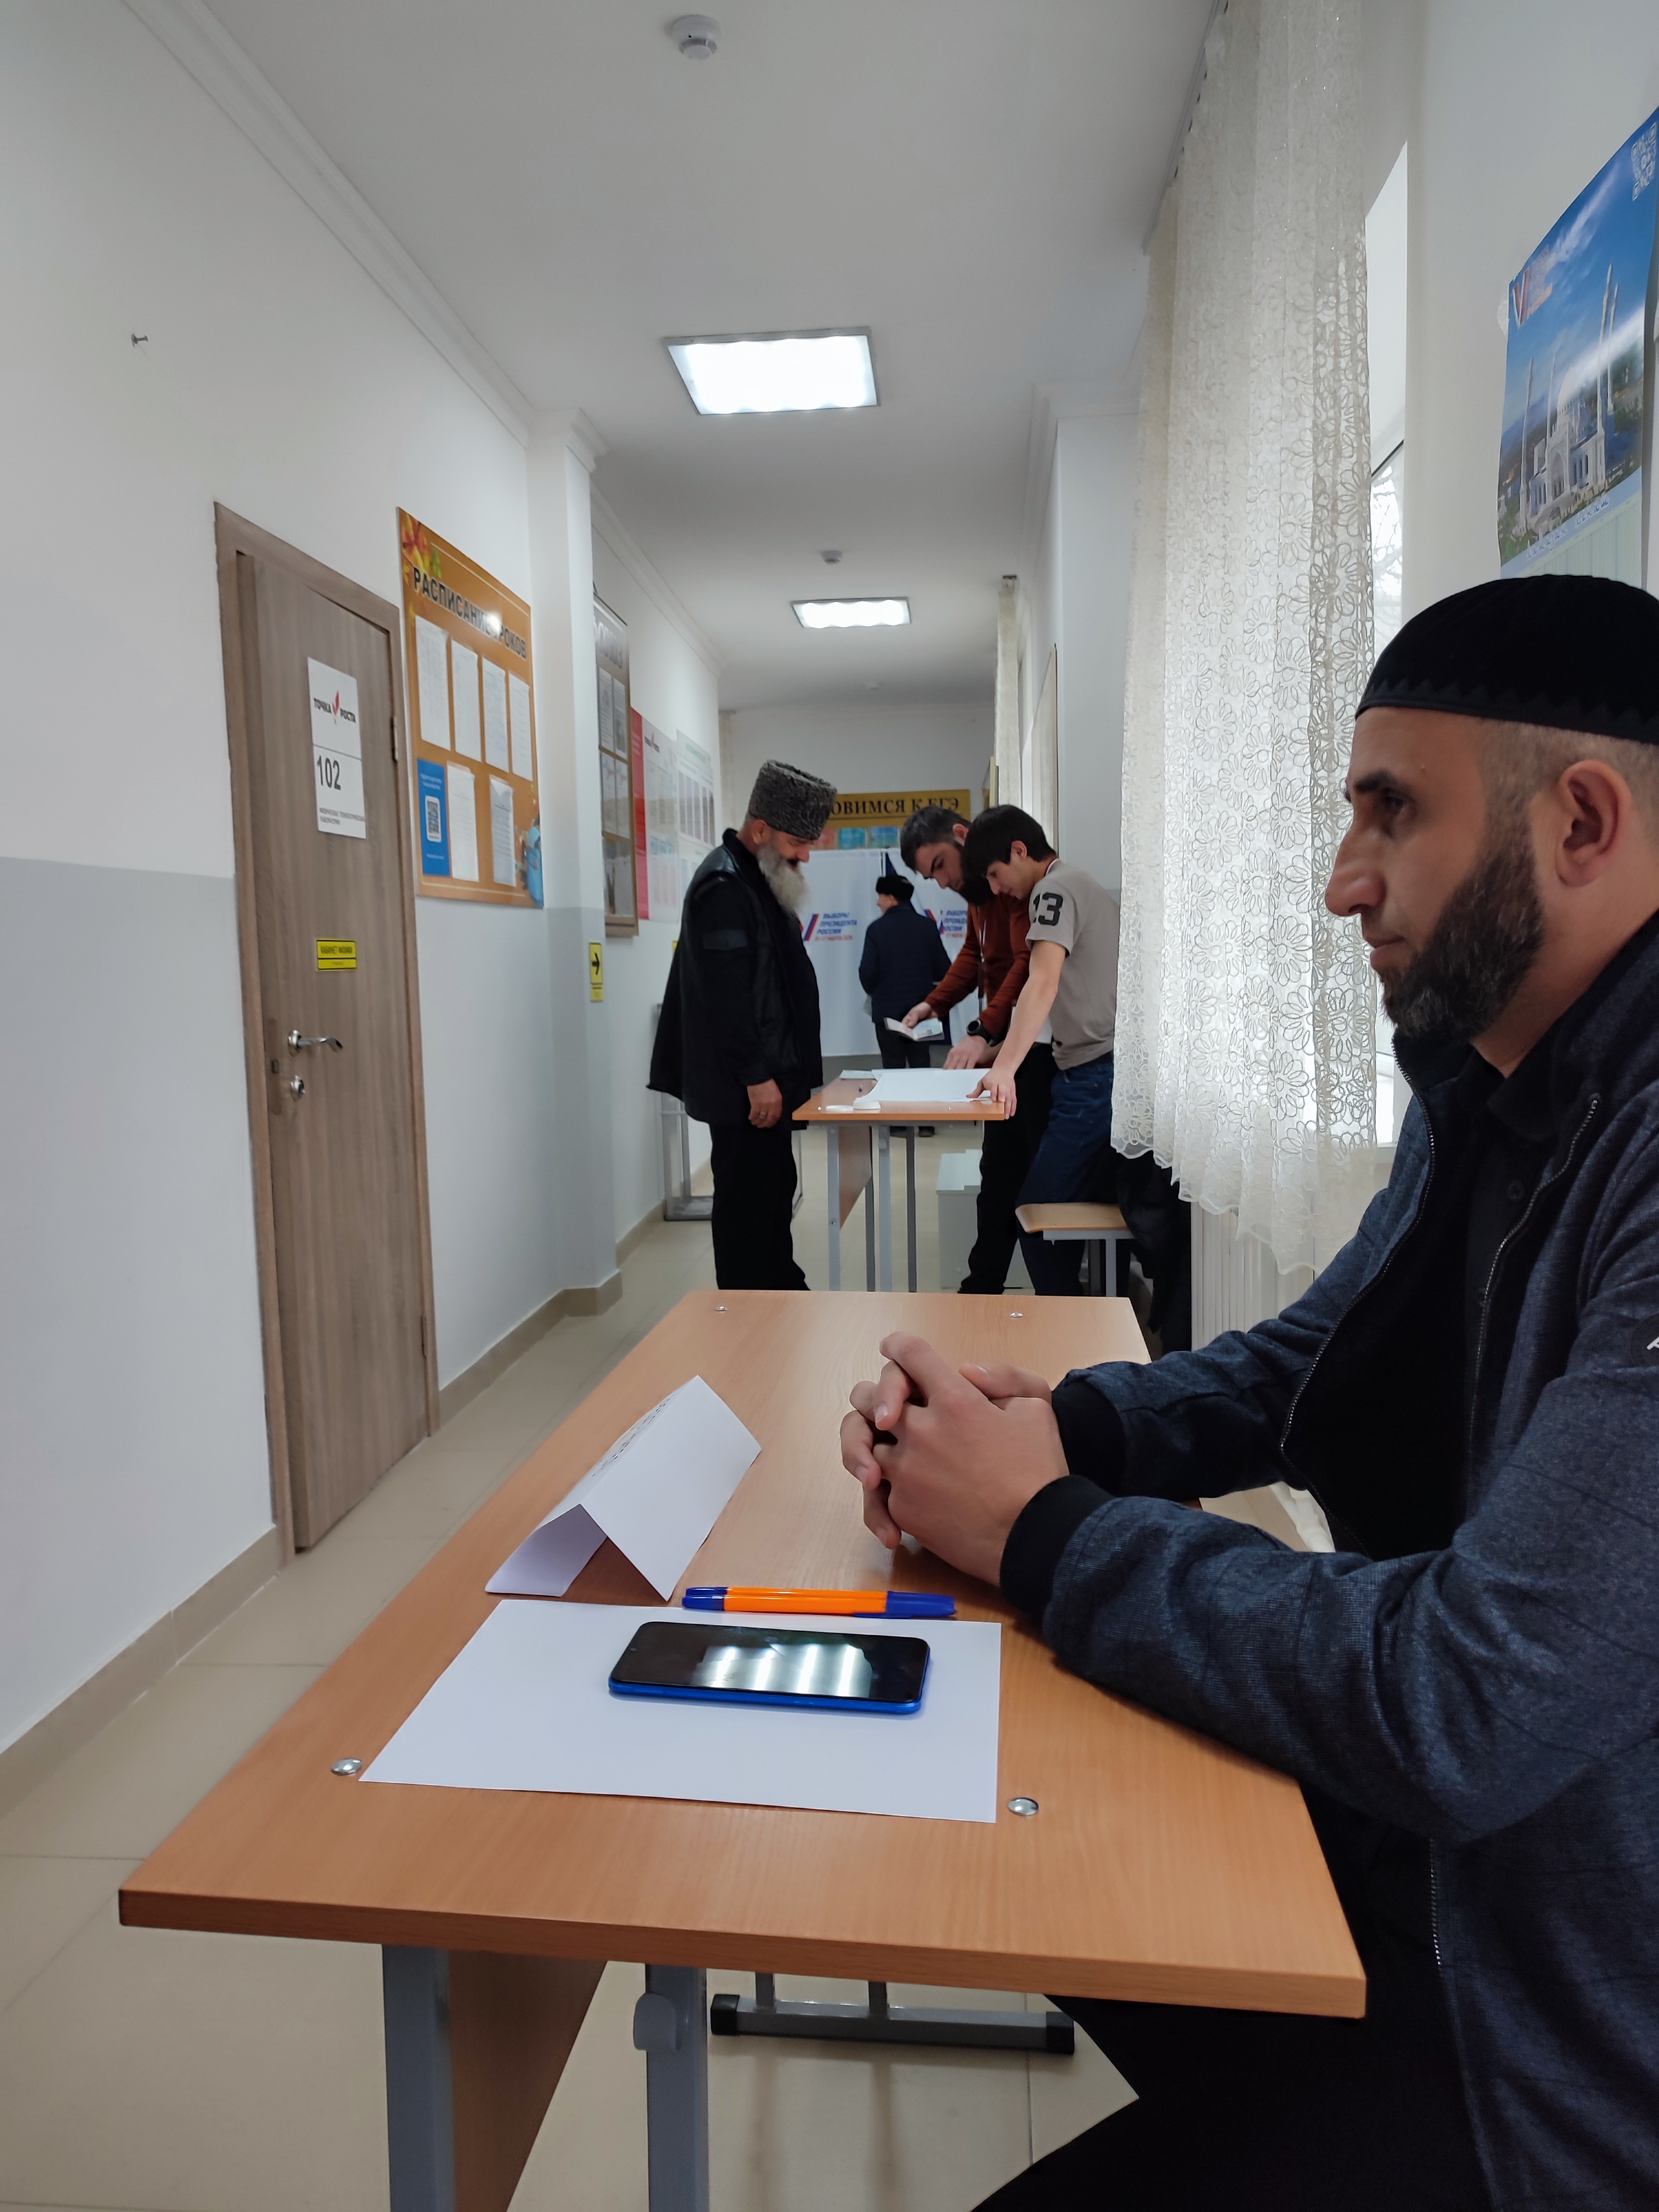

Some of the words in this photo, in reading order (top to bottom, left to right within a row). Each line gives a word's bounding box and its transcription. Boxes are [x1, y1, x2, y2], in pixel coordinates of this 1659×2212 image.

[493, 622, 526, 659] РОКОВ
[317, 755, 341, 791] 102
[831, 800, 905, 815] ОВИМСЯ
